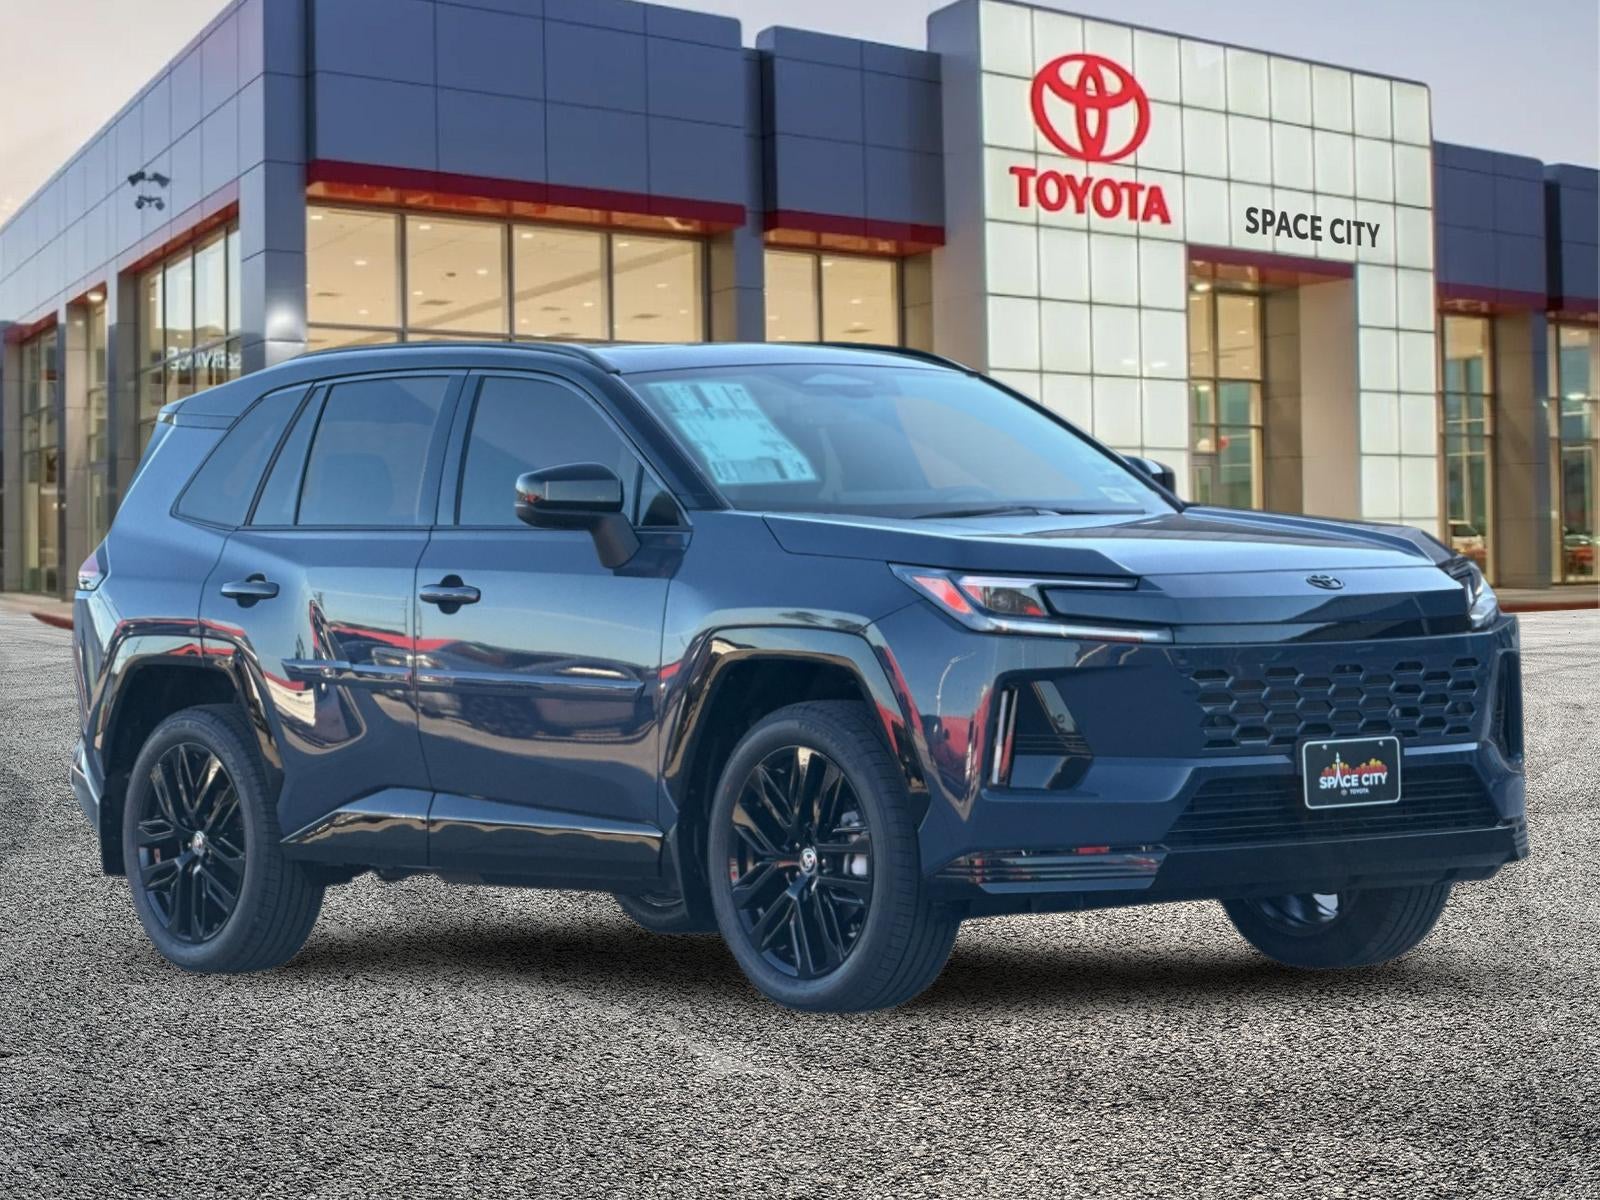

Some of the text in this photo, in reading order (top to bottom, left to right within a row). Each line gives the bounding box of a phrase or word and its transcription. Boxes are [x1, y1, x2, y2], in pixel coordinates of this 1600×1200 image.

[1009, 166, 1171, 225] TOYOTA
[1245, 206, 1381, 248] SPACE CITY
[1319, 772, 1388, 789] SPACE CITY
